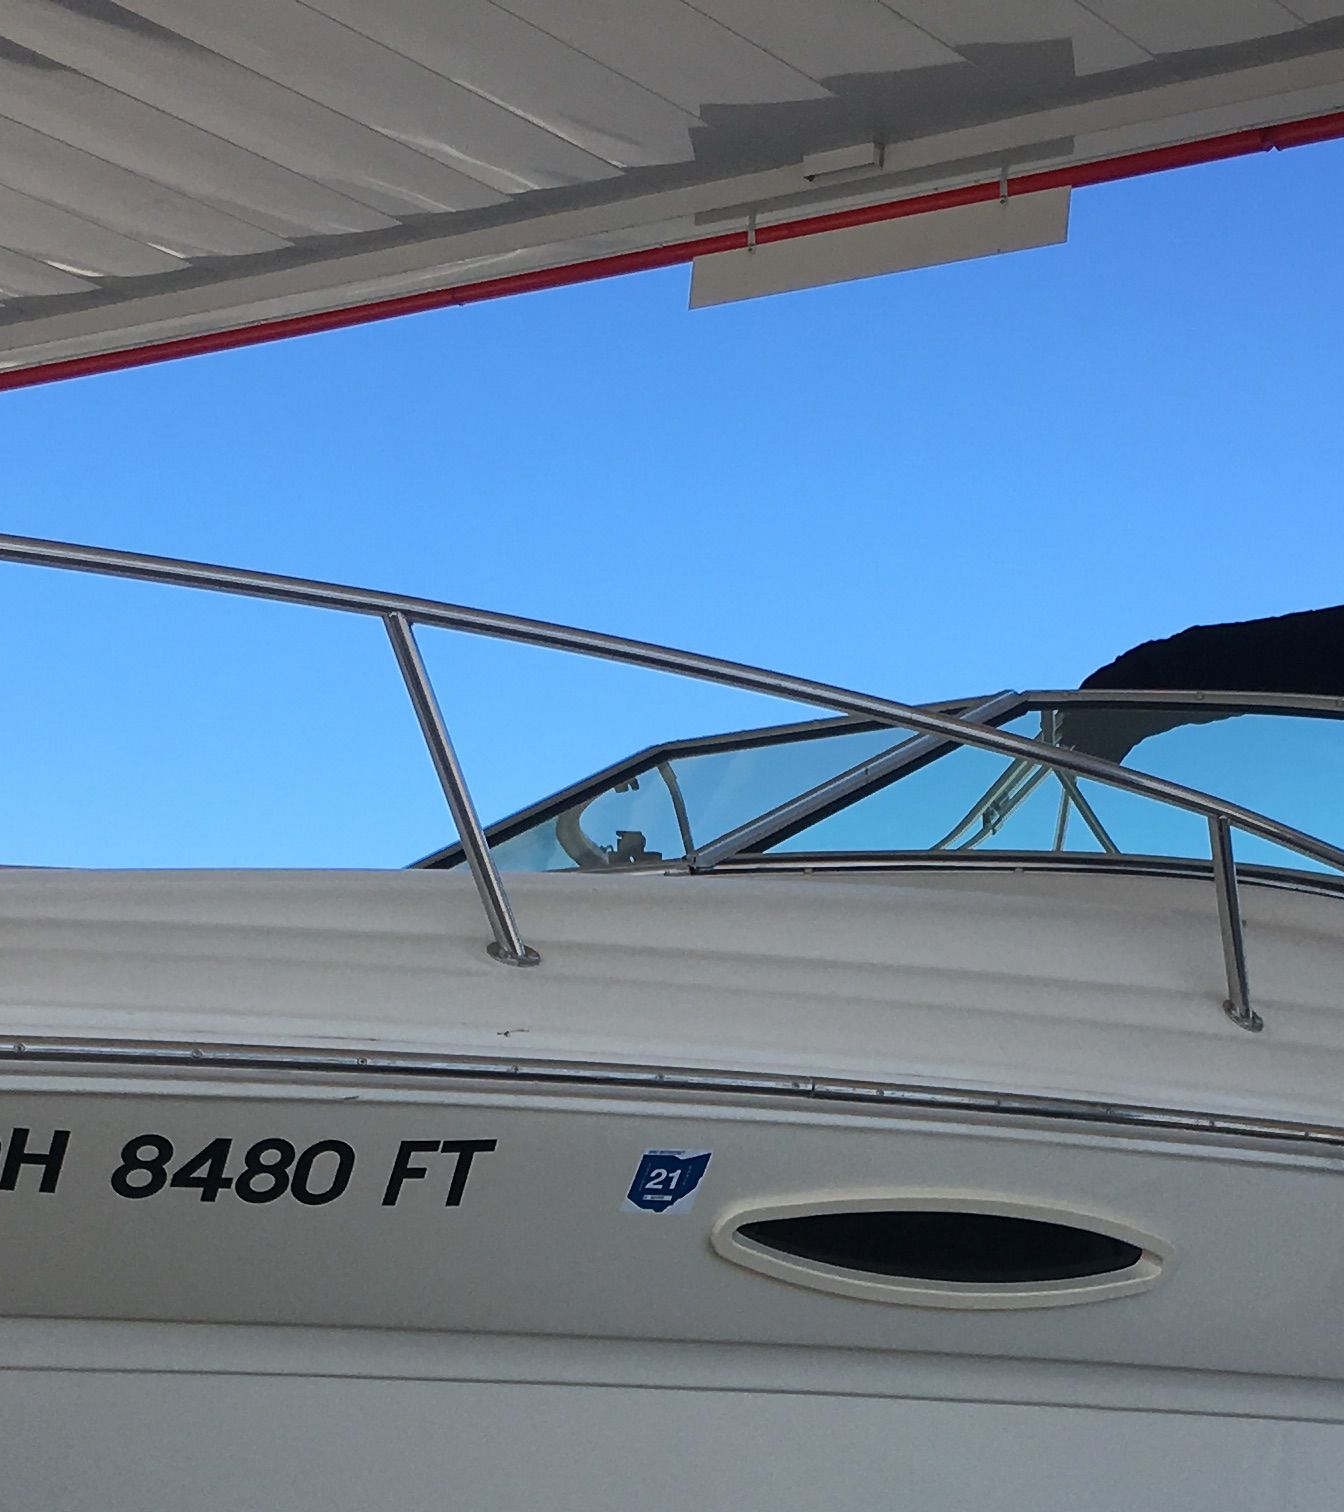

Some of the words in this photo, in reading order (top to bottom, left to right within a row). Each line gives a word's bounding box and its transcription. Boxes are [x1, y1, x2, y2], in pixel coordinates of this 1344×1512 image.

[111, 1134, 355, 1205] 8480
[382, 1139, 497, 1206] FT
[644, 1168, 682, 1190] 21
